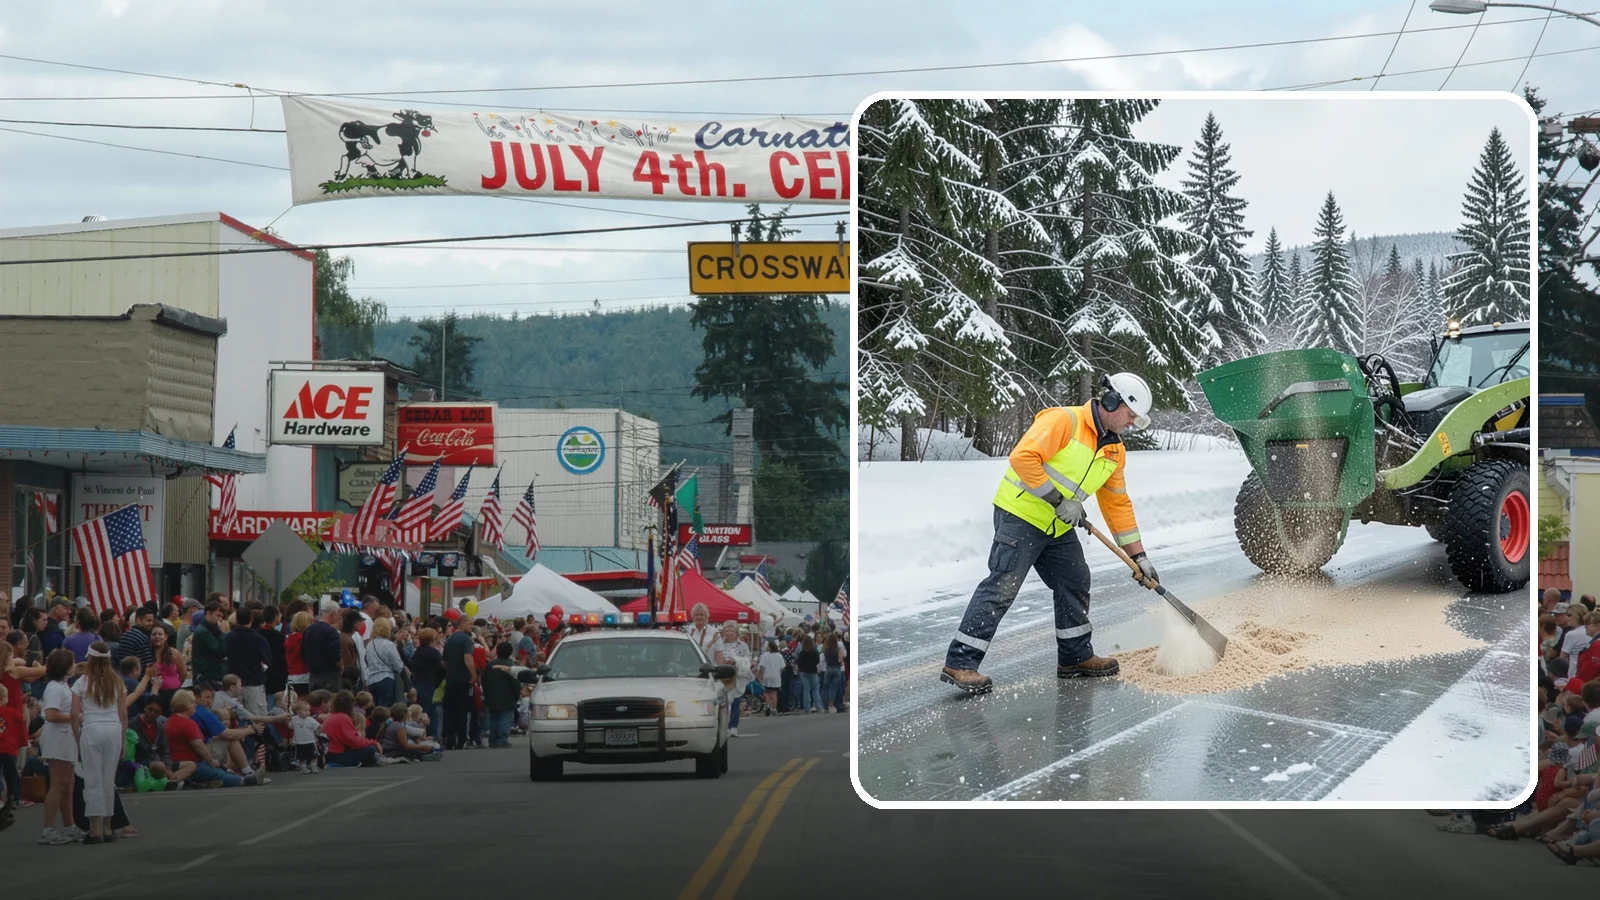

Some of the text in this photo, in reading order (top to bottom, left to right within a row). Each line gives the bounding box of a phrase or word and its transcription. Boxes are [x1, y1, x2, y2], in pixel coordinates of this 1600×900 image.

[695, 121, 850, 150] Carnat
[481, 141, 605, 192] JULY
[632, 150, 746, 198] 4th.
[282, 380, 373, 419] ACE
[405, 409, 485, 422] CEDAR LOG
[283, 421, 370, 436] Hardware
[416, 428, 477, 447] Coca-Cola
[83, 484, 155, 495] St. Vincent de Paul
[688, 526, 741, 535] CRNATION
[699, 535, 730, 543] GLASS
